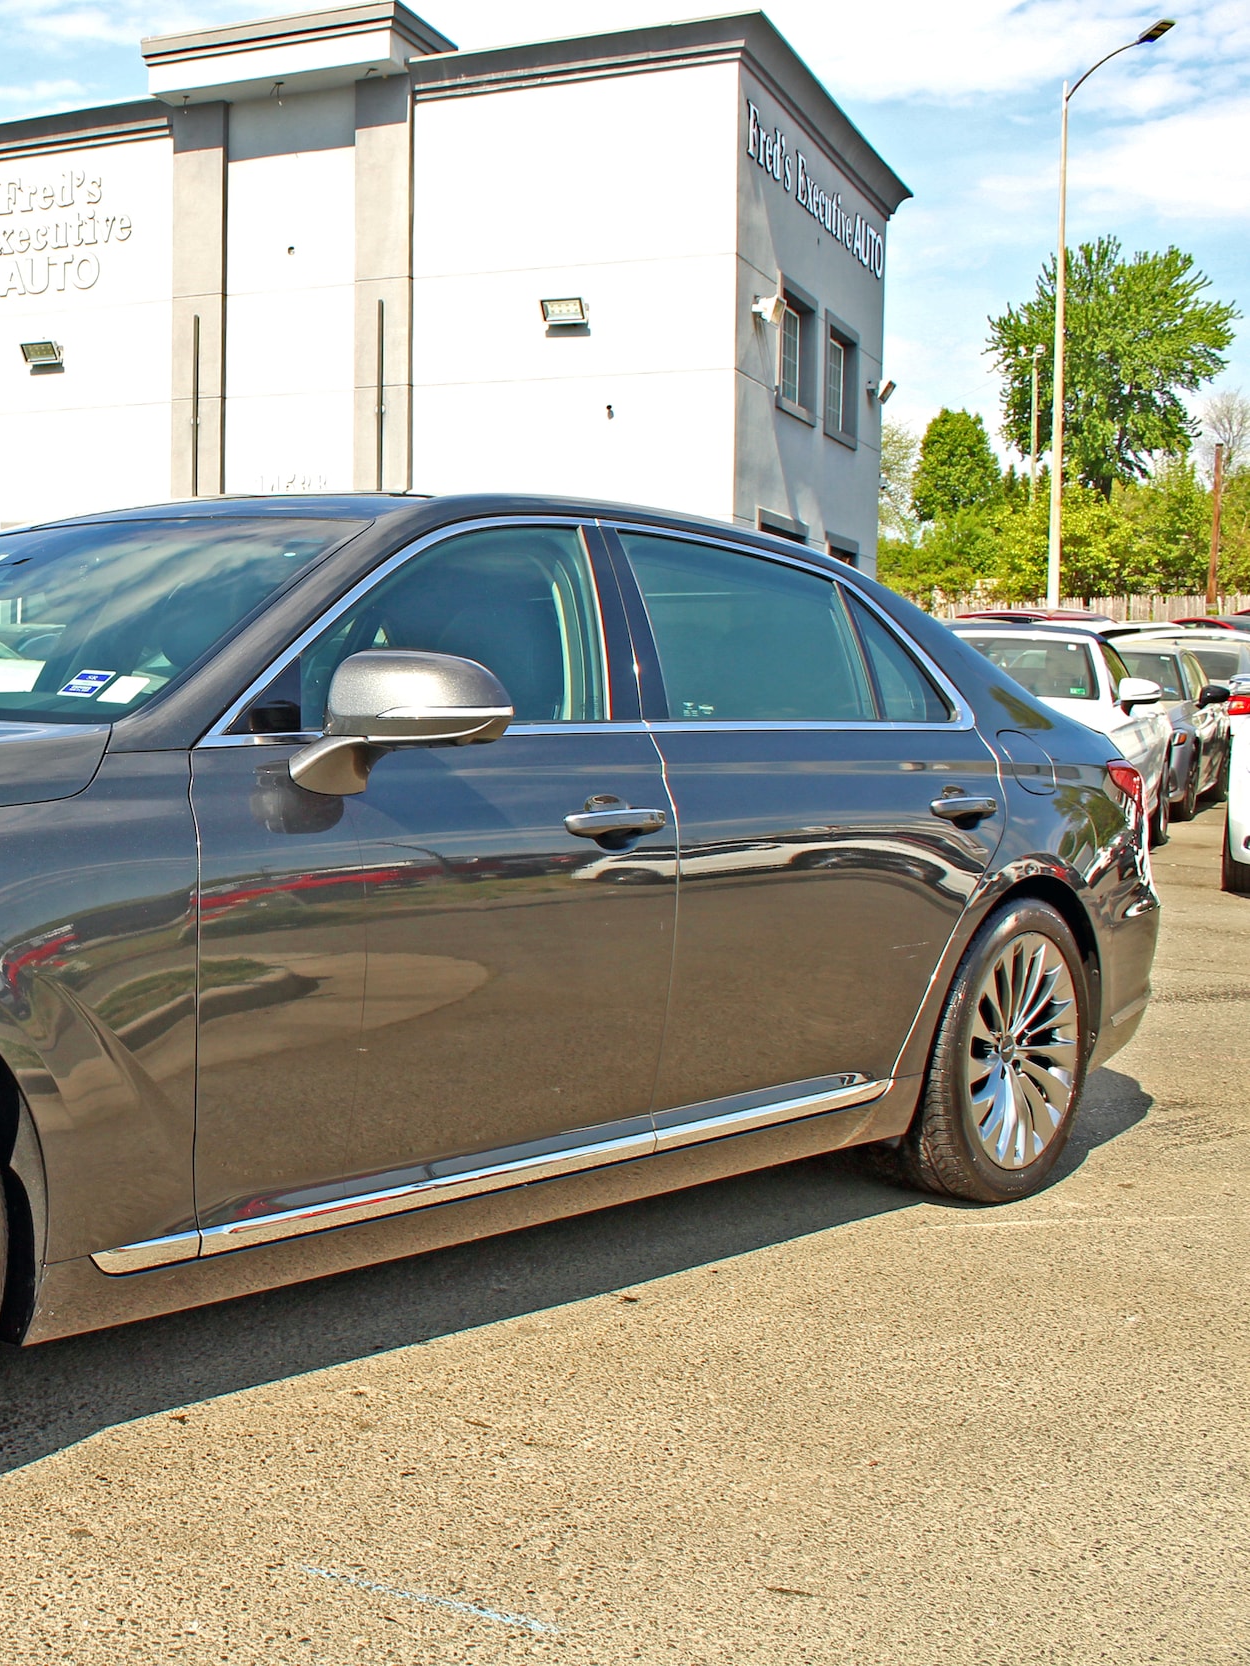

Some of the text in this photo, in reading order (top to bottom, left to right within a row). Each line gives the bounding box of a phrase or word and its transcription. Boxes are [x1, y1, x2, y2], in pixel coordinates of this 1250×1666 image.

[747, 99, 884, 279] Fred's Executive AUTO
